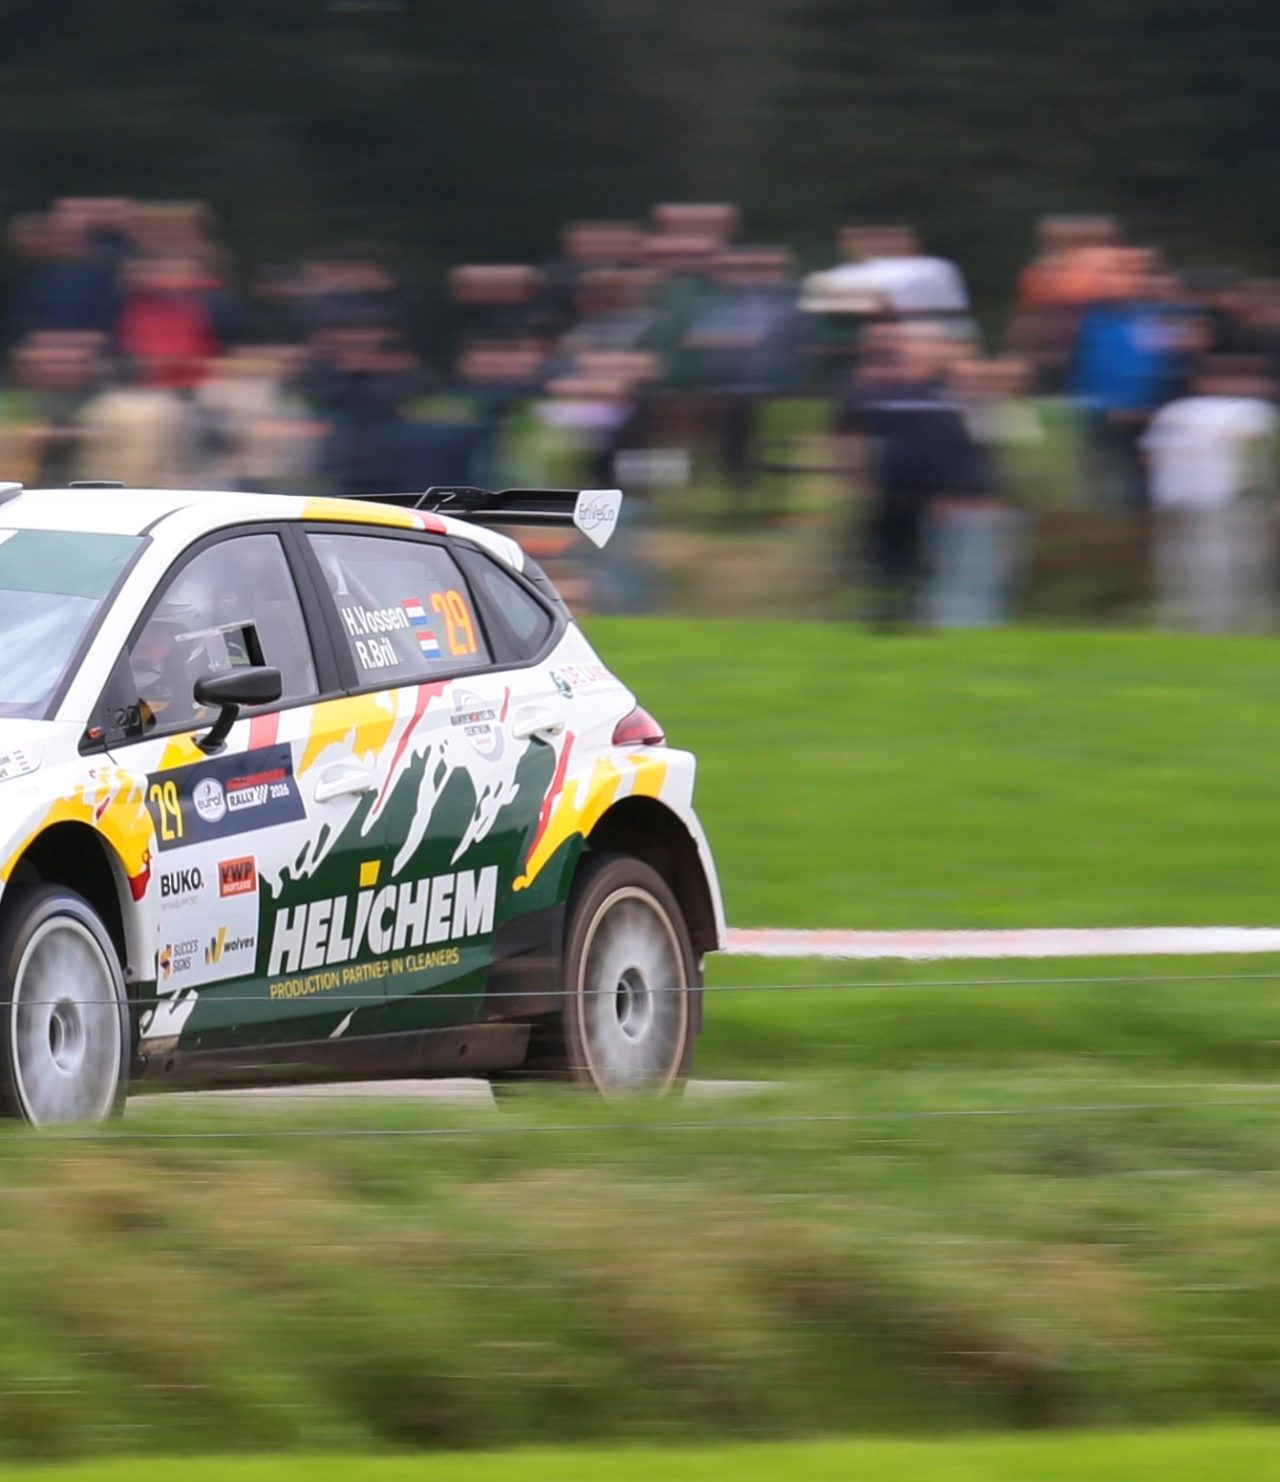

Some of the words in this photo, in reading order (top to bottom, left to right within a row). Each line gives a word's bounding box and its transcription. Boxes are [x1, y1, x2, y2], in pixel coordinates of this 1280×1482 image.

[341, 606, 410, 636] H.Vossen
[429, 589, 479, 656] 29
[355, 637, 398, 670] R.Bril
[149, 780, 183, 841] 29
[228, 790, 256, 808] RALLY
[267, 860, 499, 977] HELICHEM
[269, 972, 340, 1001] PRODUCTION
[342, 961, 389, 985] PARTNER
[391, 959, 404, 974] IN
[406, 946, 460, 973] CLEANERS
